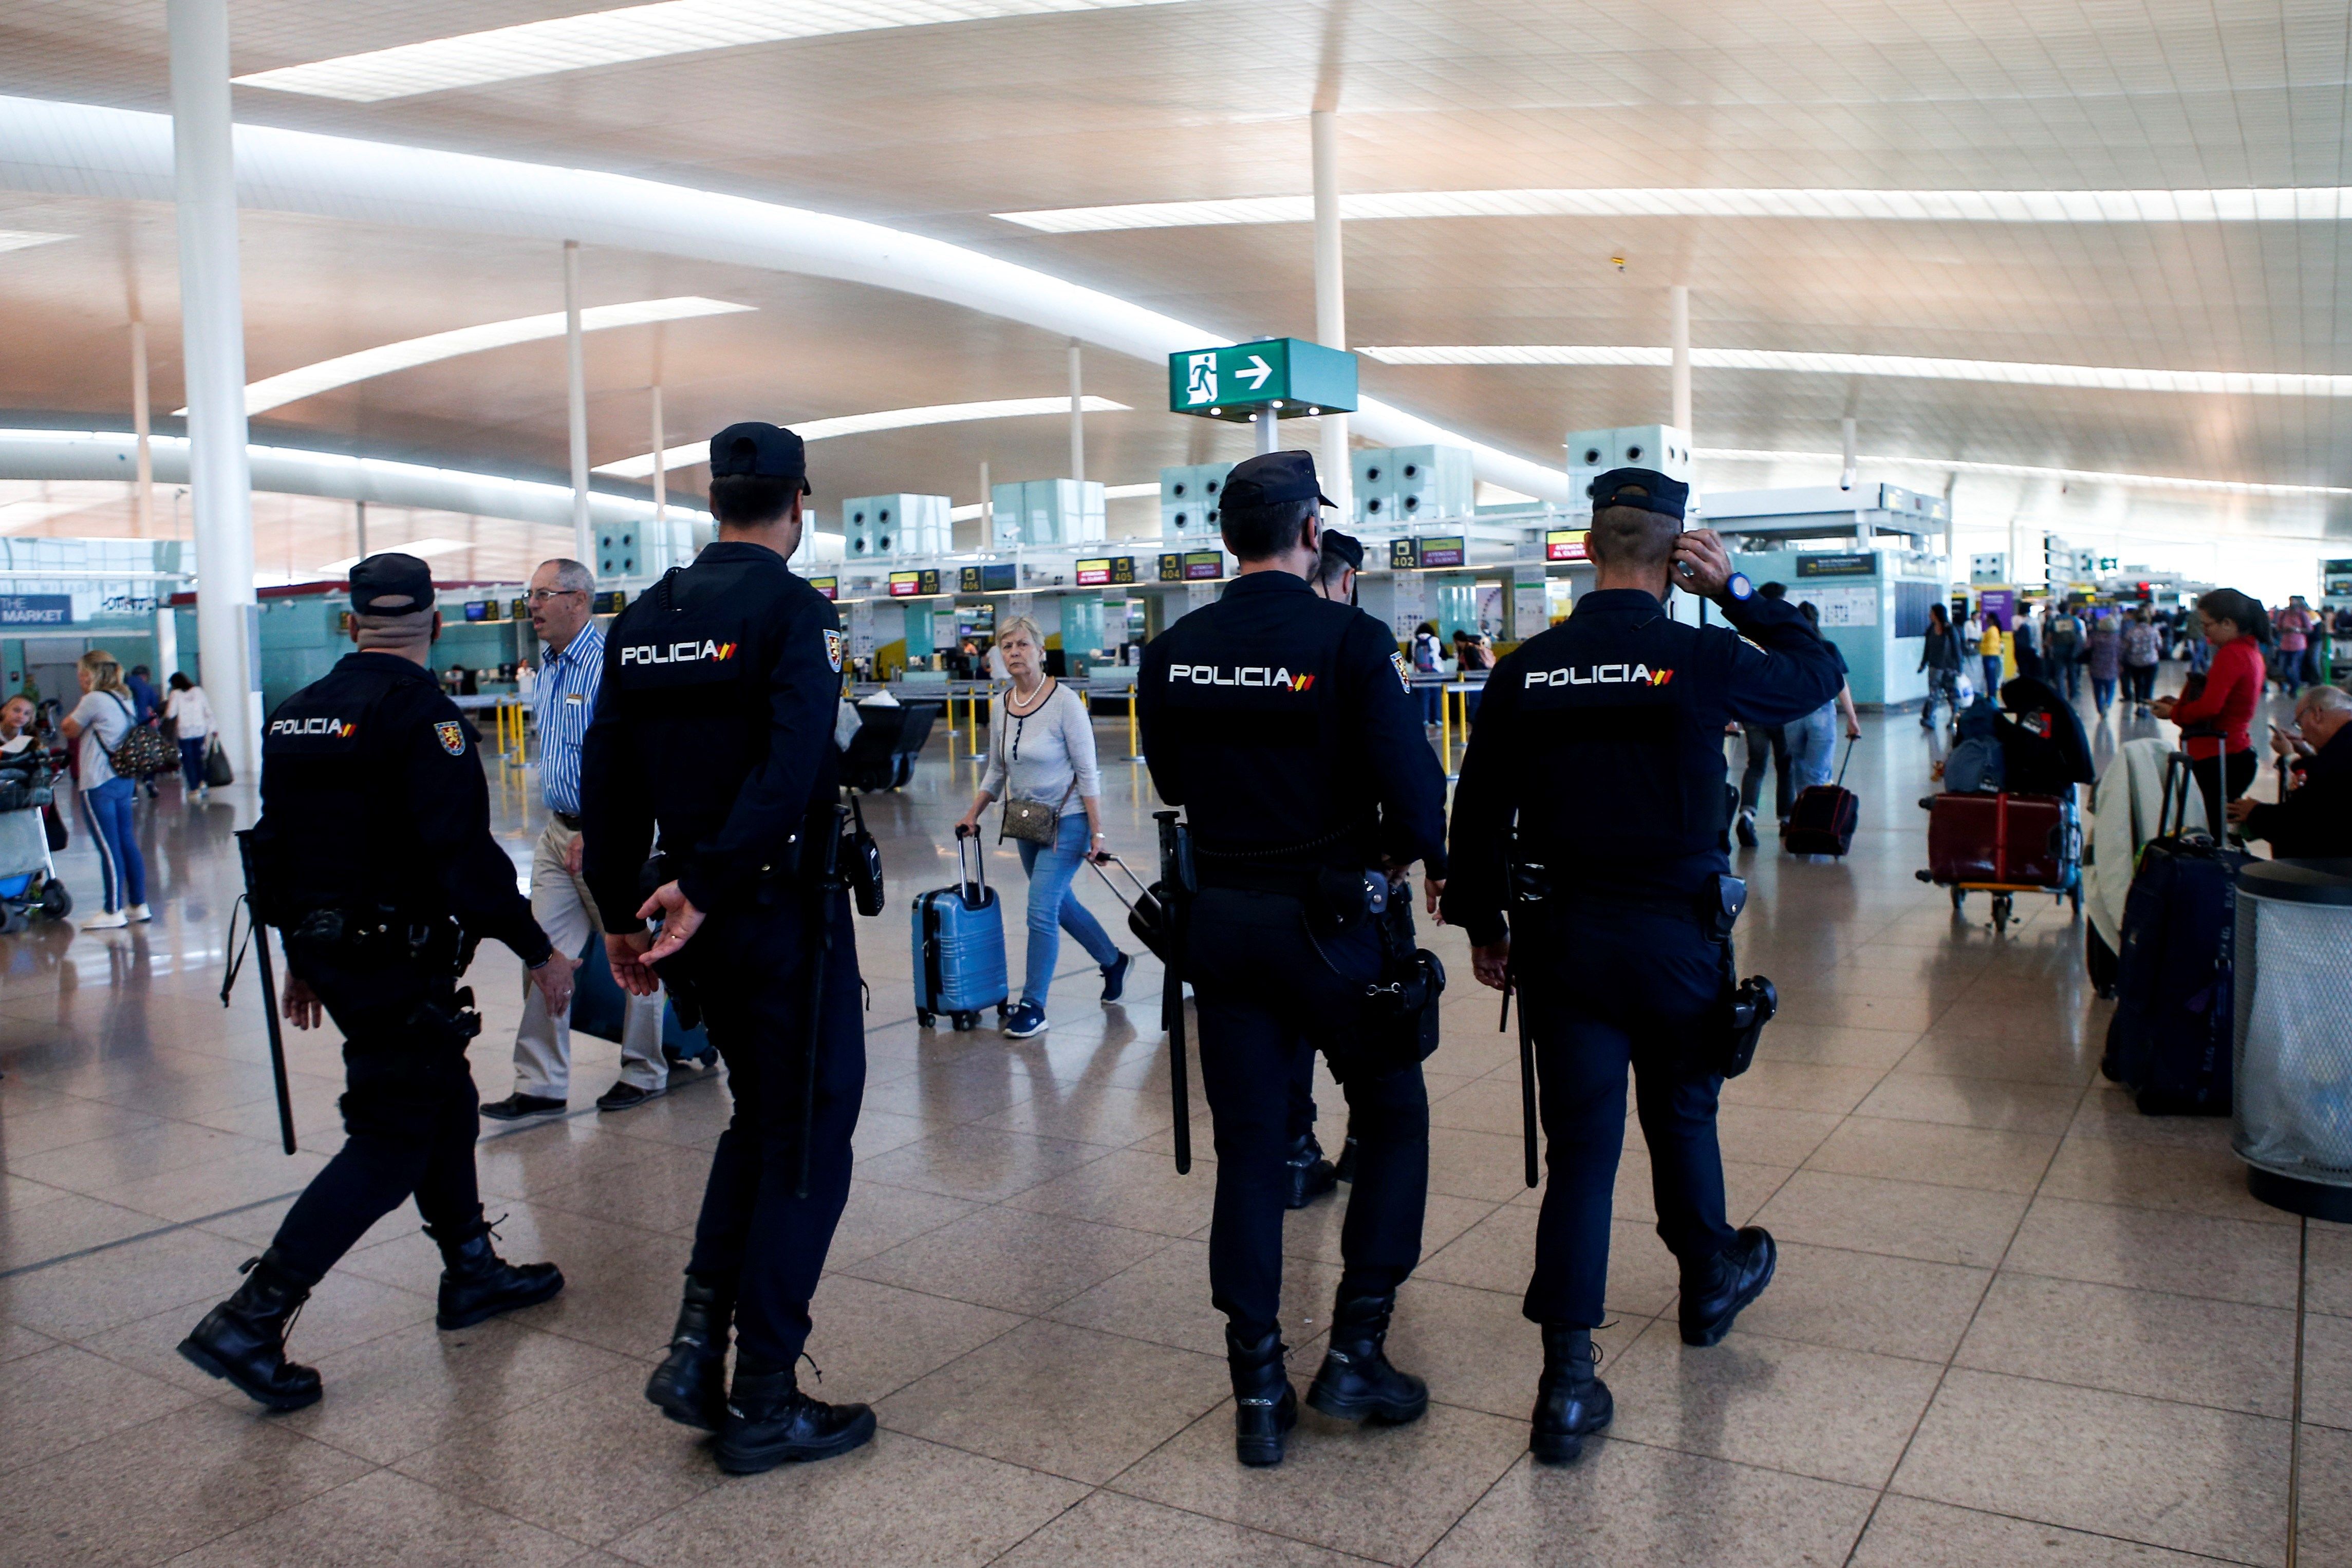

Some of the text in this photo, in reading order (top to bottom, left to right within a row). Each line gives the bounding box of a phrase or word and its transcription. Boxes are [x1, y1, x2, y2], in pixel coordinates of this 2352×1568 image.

[1393, 556, 1414, 567] 402
[1115, 572, 1132, 581] 405
[1162, 570, 1180, 578] 404
[923, 584, 938, 592] 407
[963, 581, 979, 590] 406
[0, 598, 26, 610] THE
[2, 610, 64, 622] MARKET
[621, 639, 720, 666] POLICIA
[1169, 664, 1294, 686] POLICIA
[1524, 663, 1653, 689] POLICIA
[269, 718, 343, 736] POLICIA
